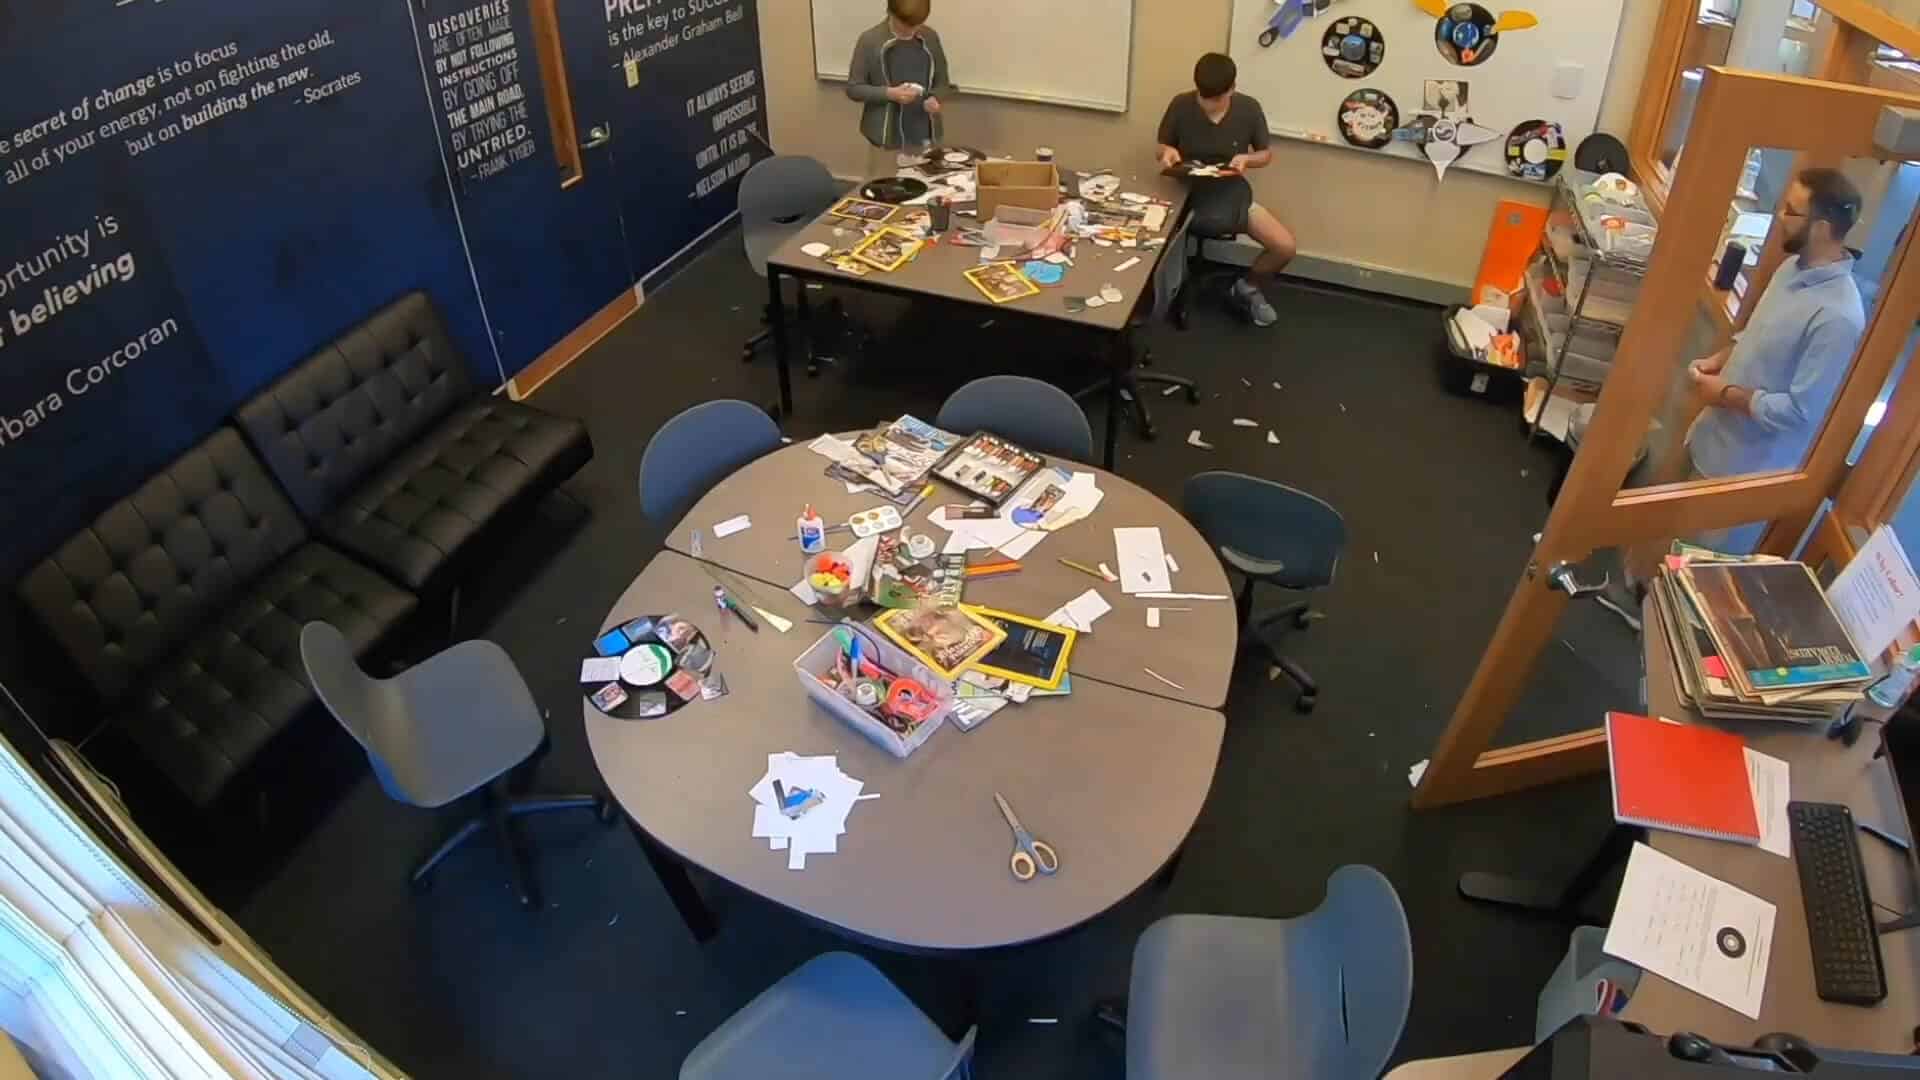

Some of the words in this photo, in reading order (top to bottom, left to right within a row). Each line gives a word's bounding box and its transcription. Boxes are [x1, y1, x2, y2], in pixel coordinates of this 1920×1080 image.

[428, 0, 510, 40] DISCOVERIES
[608, 30, 620, 46] is
[622, 21, 645, 41] the
[647, 12, 669, 31] key
[672, 8, 686, 21] to
[622, 33, 679, 66] Alexander
[682, 17, 720, 41] Graham
[725, 4, 743, 25] Bell
[435, 57, 448, 74] BY
[450, 49, 467, 68] NOT
[470, 32, 515, 60] FOLLOWING
[440, 47, 518, 89] INSTRUCTIONS
[5, 159, 29, 184] all
[31, 147, 51, 170] of
[53, 129, 96, 163] your
[99, 102, 162, 138] energy,
[164, 86, 192, 110] not
[194, 79, 217, 98] on
[218, 53, 280, 87] fighting
[281, 42, 306, 62] the
[308, 29, 335, 50] old.
[13, 109, 68, 148] secret
[71, 97, 89, 120] of
[95, 75, 156, 110] change
[158, 67, 173, 84] is
[174, 59, 192, 77] to
[194, 41, 238, 69] focus
[303, 71, 362, 104] Socrates
[442, 86, 459, 111] BY
[463, 71, 497, 101] GOING
[697, 82, 729, 113] ALWAYS
[126, 132, 157, 156] but
[158, 122, 181, 141] on
[181, 92, 248, 131] building
[251, 80, 275, 101] the
[277, 66, 315, 90] new.
[447, 107, 468, 129] THE
[469, 95, 496, 119] MAIN
[451, 128, 467, 152] BY
[469, 111, 507, 142] TRYING
[507, 101, 528, 122] THE
[457, 124, 533, 168] UNTRIED.
[0, 228, 90, 297] ortunity
[95, 214, 119, 238] is
[9, 252, 136, 336] believing
[66, 316, 179, 395] Corcoran
